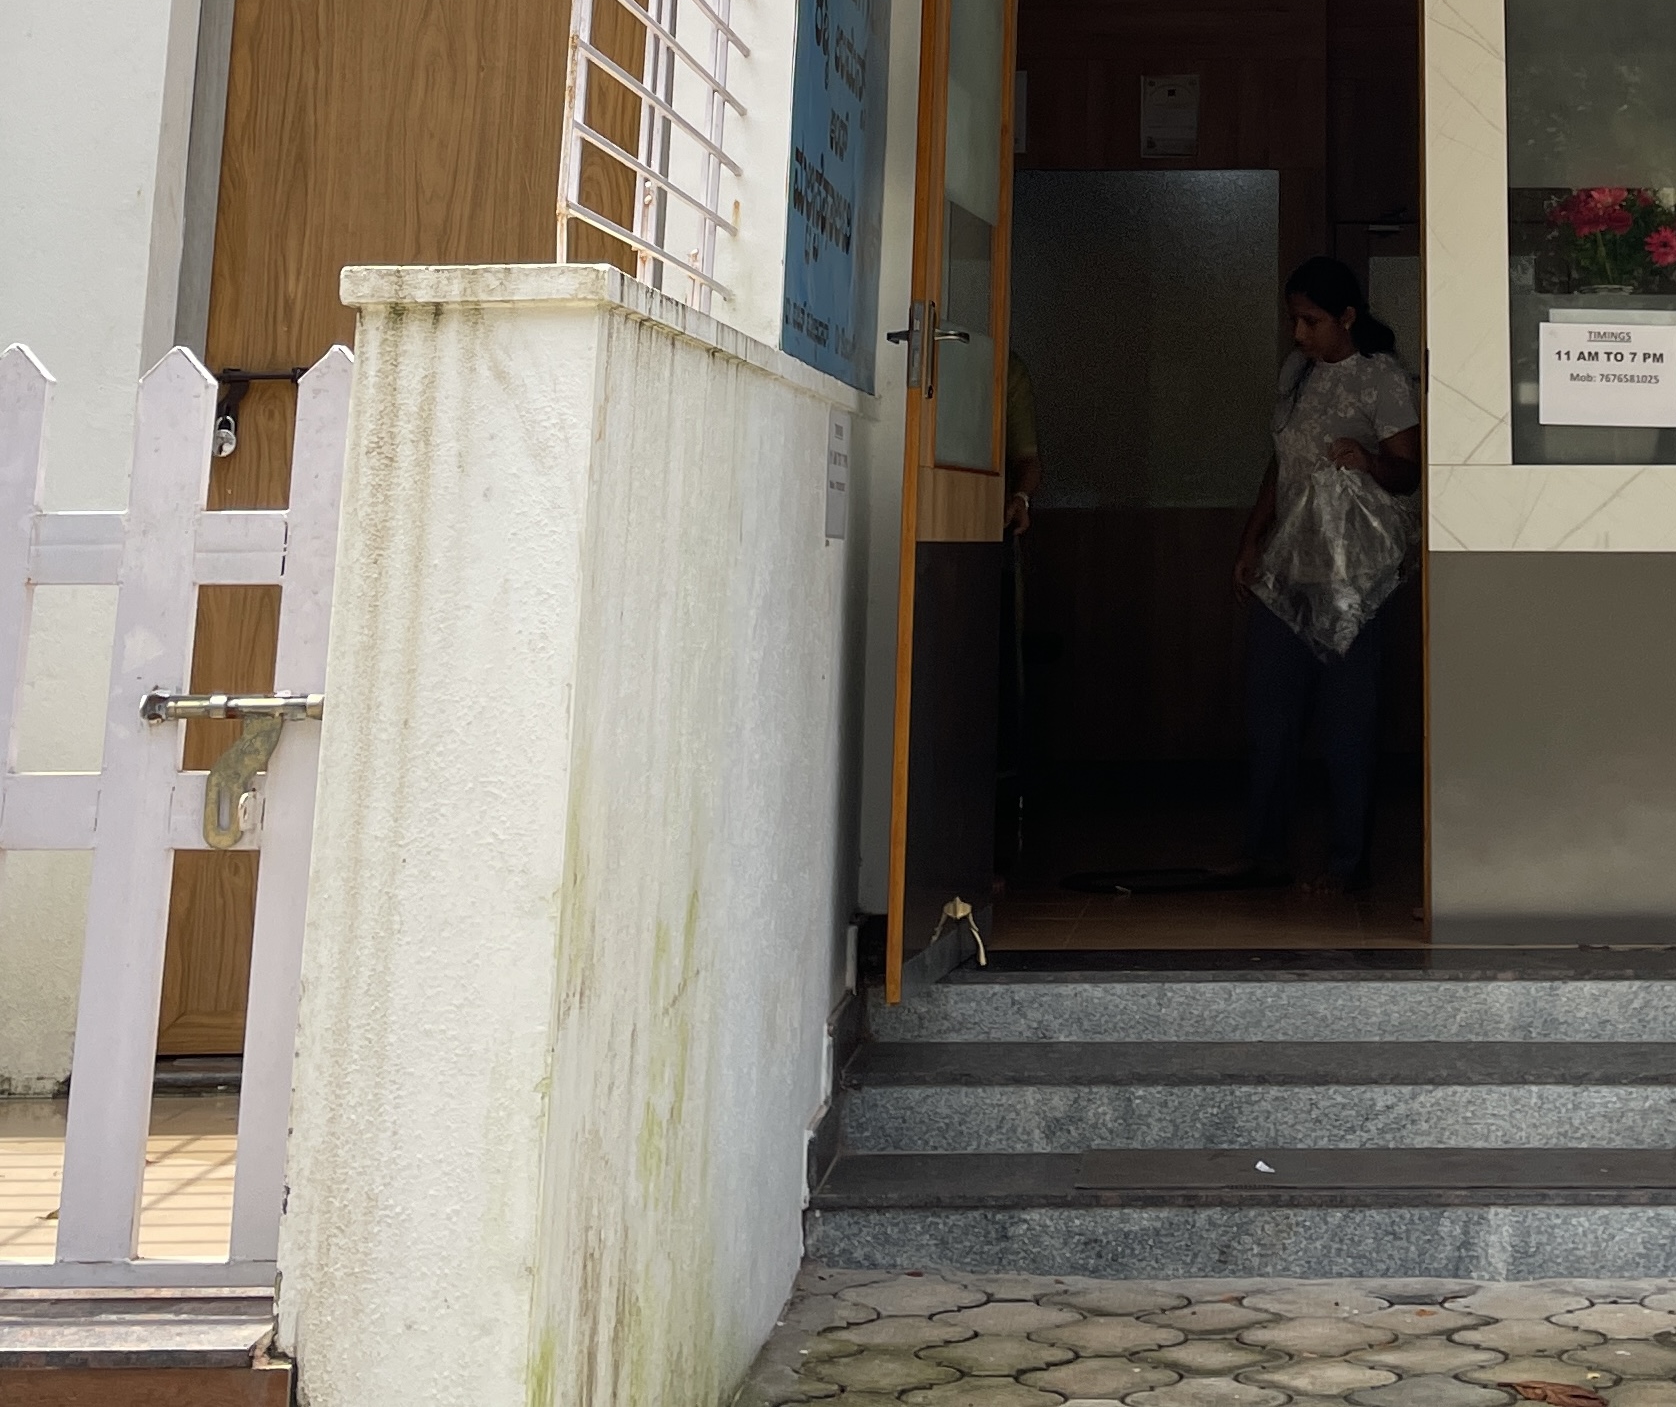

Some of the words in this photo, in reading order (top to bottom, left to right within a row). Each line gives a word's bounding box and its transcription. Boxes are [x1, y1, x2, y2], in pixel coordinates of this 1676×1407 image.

[1587, 330, 1632, 342] TIMINGS
[1555, 349, 1571, 362] 11
[1576, 350, 1600, 362] AM
[1603, 351, 1625, 363] TO
[1628, 351, 1638, 363] 7
[1642, 352, 1664, 364] PM
[1569, 372, 1597, 383] Mob:
